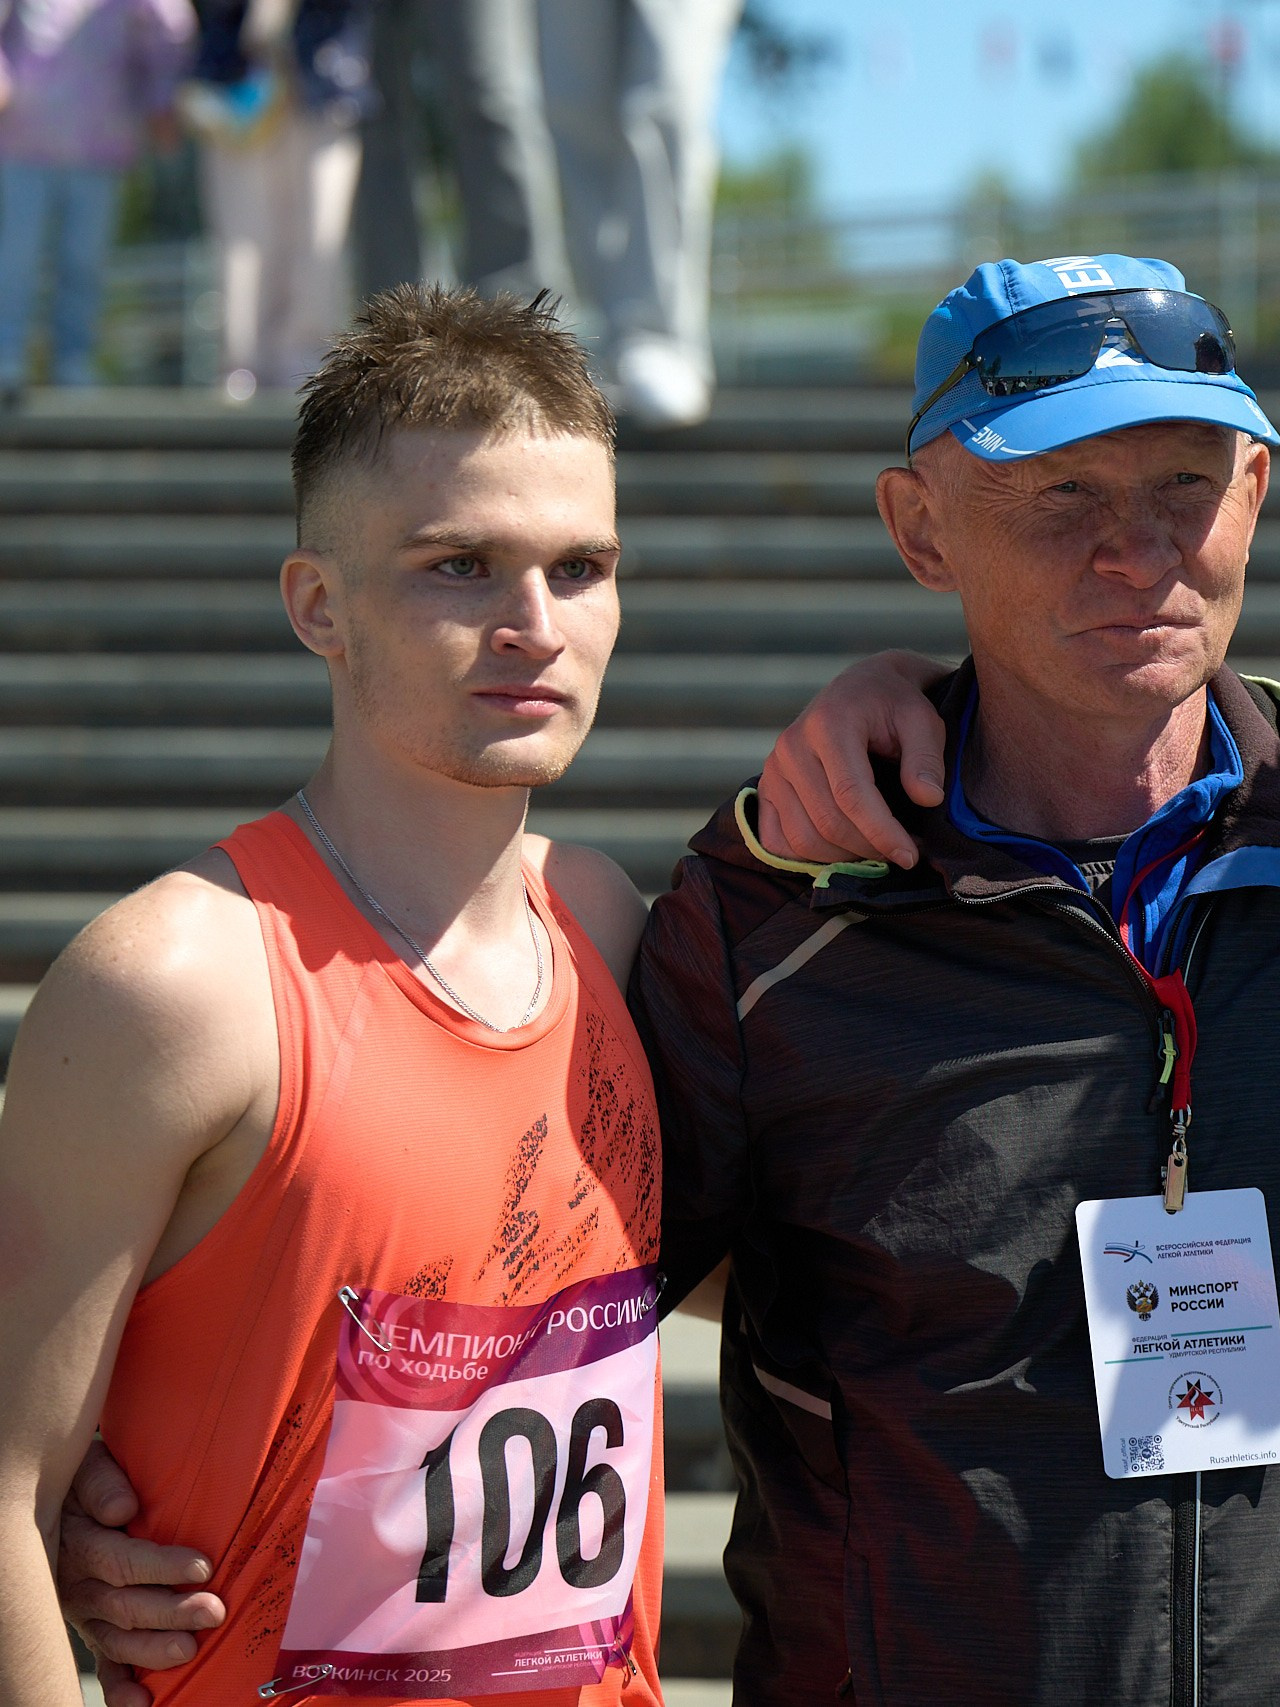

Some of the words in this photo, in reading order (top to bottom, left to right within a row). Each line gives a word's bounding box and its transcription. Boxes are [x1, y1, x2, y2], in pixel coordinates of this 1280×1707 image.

[971, 425, 1006, 453] NIKE
[1156, 1240, 1213, 1251] ВСЕРОССИЙСКАЯ
[1214, 1237, 1251, 1246] ФЕДЕРАЦИЯ
[1157, 1250, 1181, 1259] ЛЕГКОЙ
[1183, 1249, 1213, 1257] АТЛЕТИКИ
[1169, 1281, 1239, 1297] МИНСПОРТ
[1171, 1298, 1225, 1313] РОССИИ
[547, 1296, 643, 1335] РОССИИ
[1131, 1335, 1168, 1343] ФЕДЕРАЦИЯ
[1133, 1338, 1181, 1354] ЛЕГКОЙ
[1183, 1335, 1245, 1349] АТЛЕТИКИ
[358, 1350, 392, 1370] по
[400, 1357, 488, 1383] ходьбе
[1210, 1451, 1277, 1464] Rusathletics.info
[415, 1397, 627, 1603] 106
[514, 1655, 552, 1667] ЛЕГКОЙ
[553, 1650, 603, 1664] АТЛЕТИКИ
[404, 1668, 452, 1683] 2025
